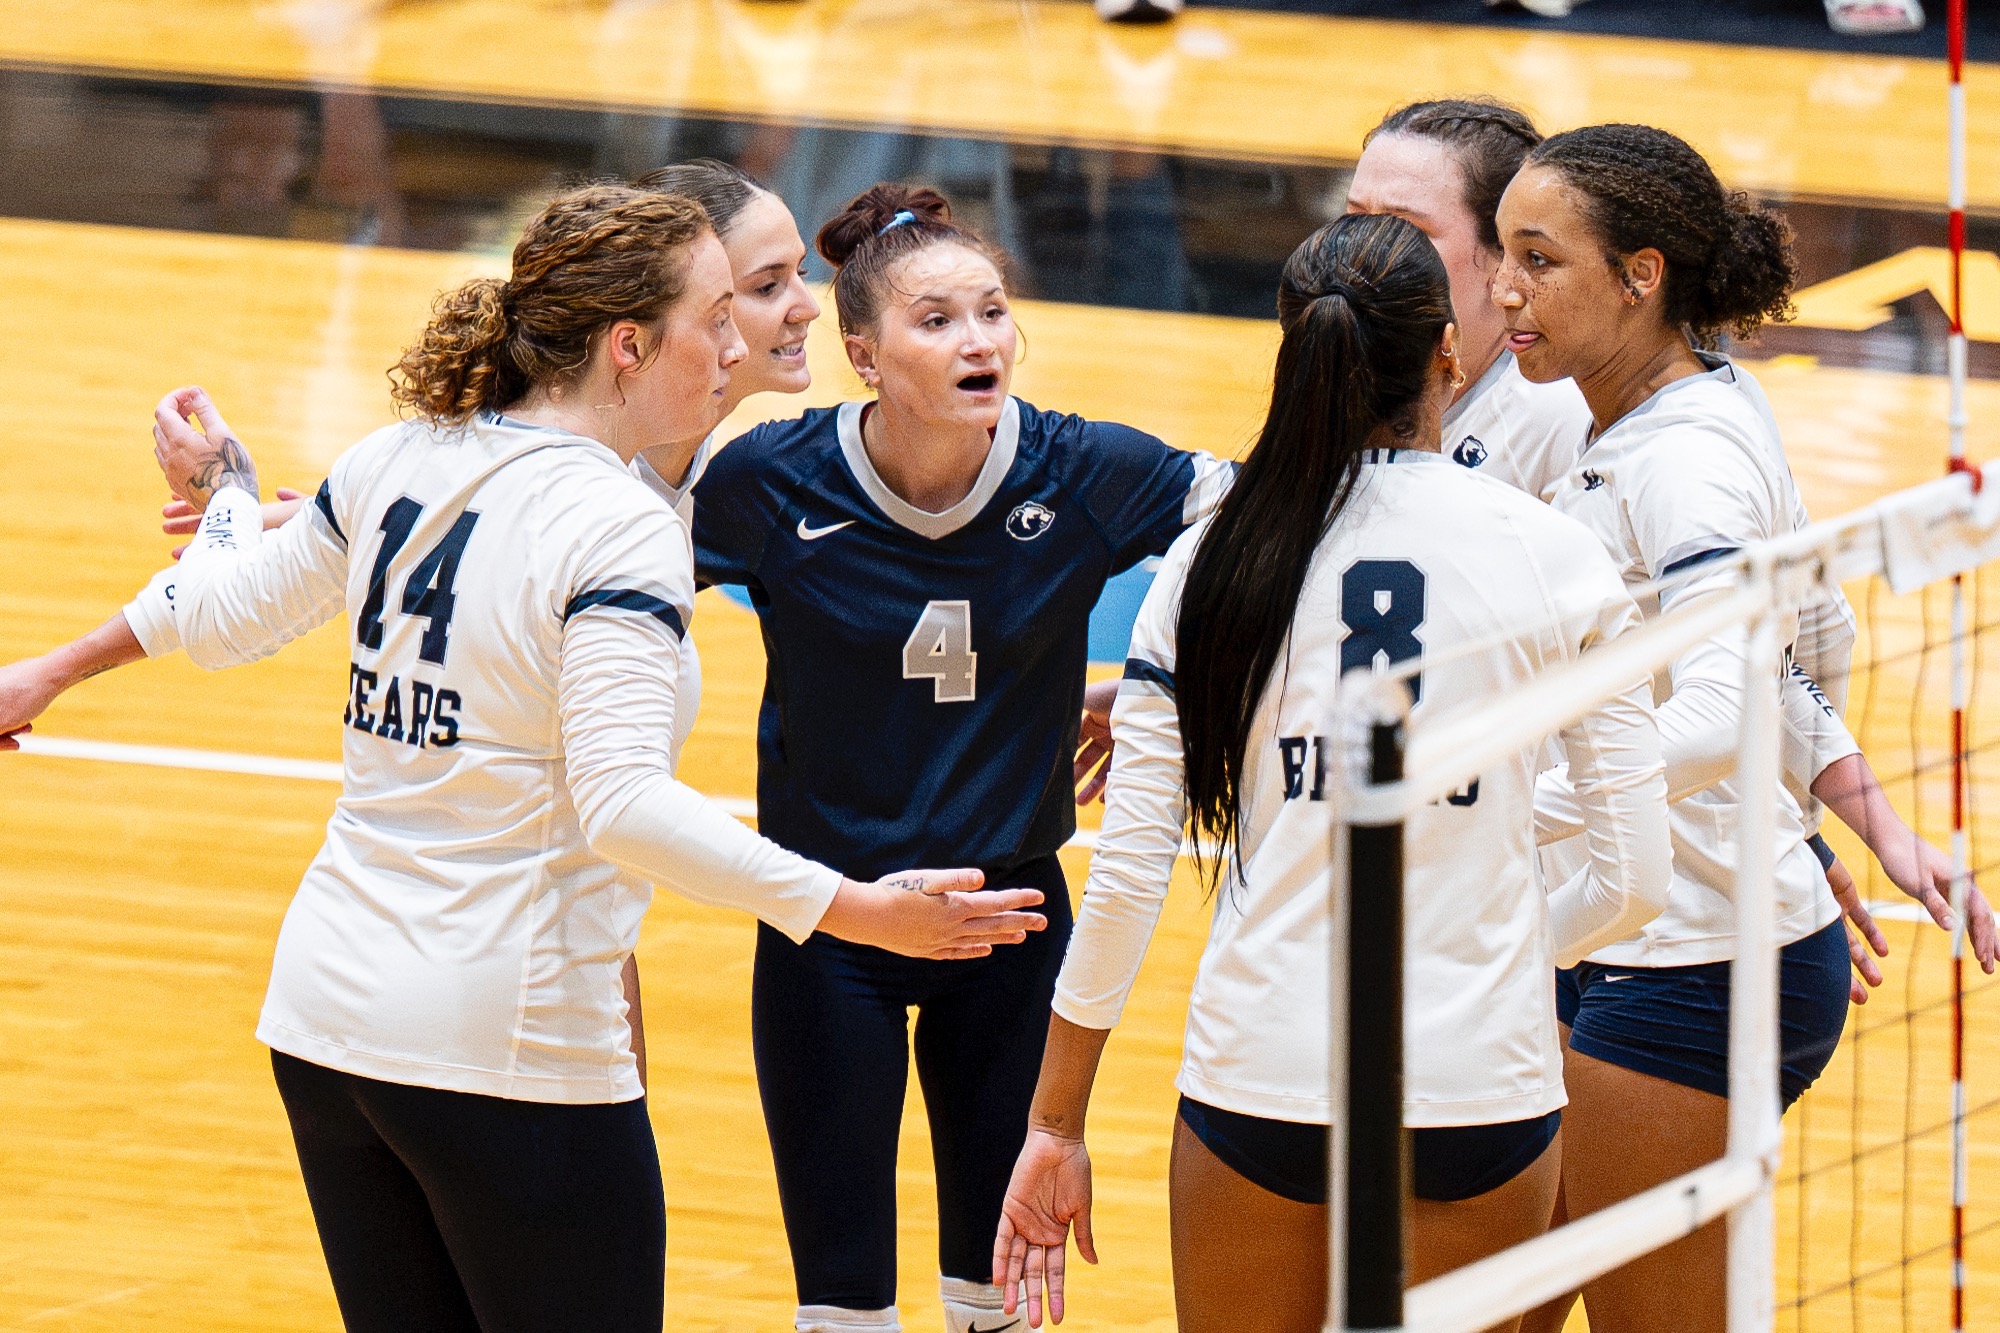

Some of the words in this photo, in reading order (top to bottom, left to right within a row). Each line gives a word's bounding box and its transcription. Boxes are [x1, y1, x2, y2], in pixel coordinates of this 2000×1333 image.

[356, 491, 483, 670] 14
[902, 600, 977, 703] 4
[1336, 556, 1429, 717] 8
